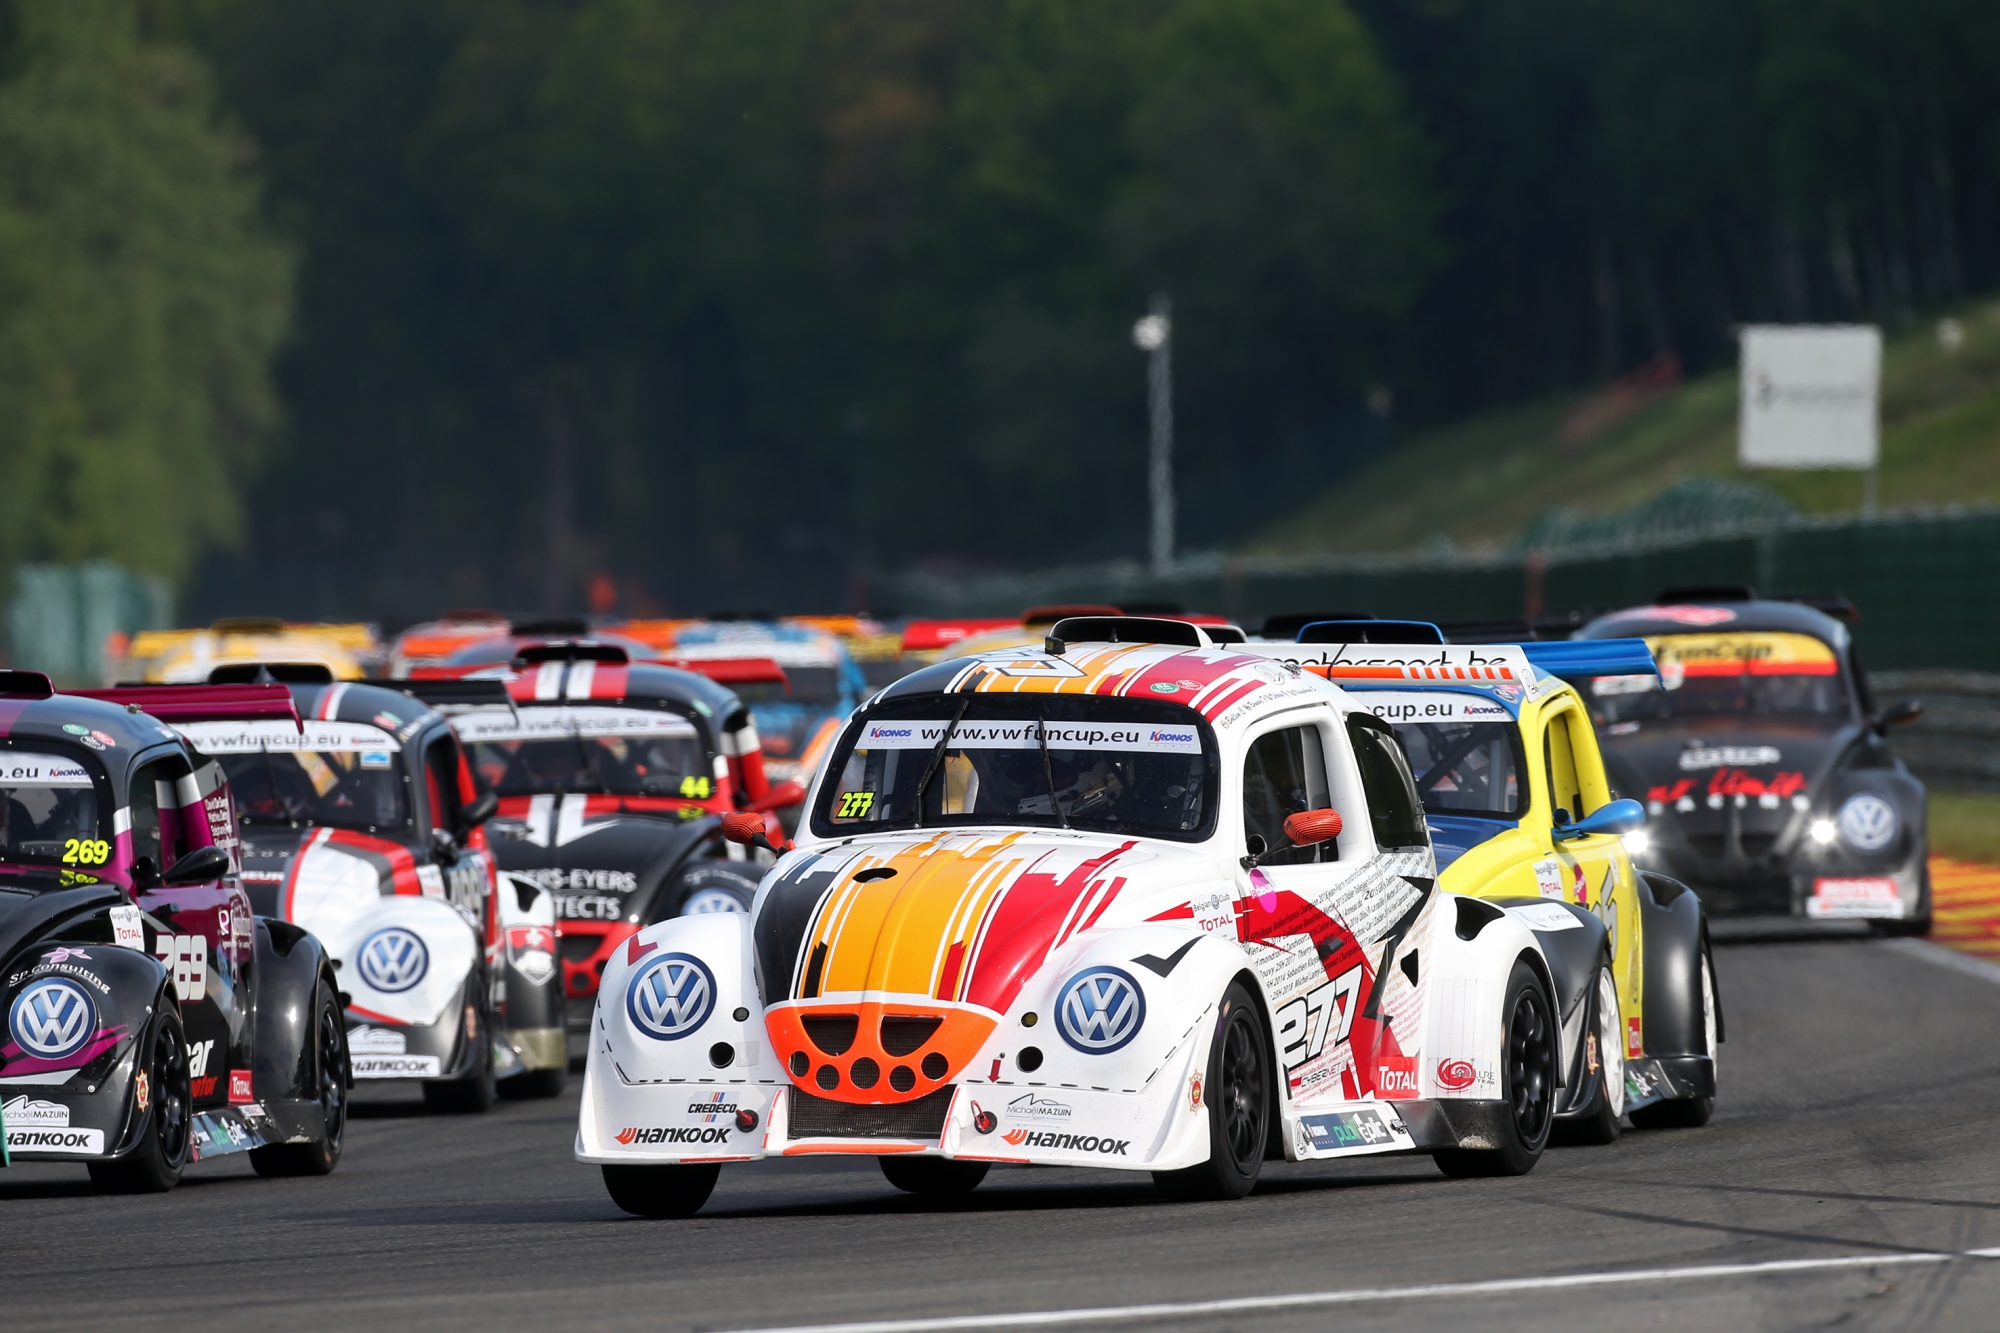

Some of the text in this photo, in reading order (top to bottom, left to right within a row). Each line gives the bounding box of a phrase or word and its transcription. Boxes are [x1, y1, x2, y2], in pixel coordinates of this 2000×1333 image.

[1367, 704, 1452, 721] cup.eu
[1463, 704, 1504, 715] KRONOS
[870, 725, 912, 738] KRONOS
[921, 725, 1139, 745] www.vwfuncup.eu
[1150, 728, 1193, 742] KRONOS
[49, 768, 89, 777] KRONOS
[680, 776, 709, 798] 44
[836, 791, 876, 818] 277
[62, 839, 108, 864] 269
[1540, 880, 1561, 894] TOTAL
[1193, 893, 1230, 912] Belgian Club
[1199, 914, 1233, 931] TOTAL
[116, 928, 142, 940] TOTAL
[9, 963, 111, 995] SP Consulting
[1276, 963, 1363, 1070] 277
[232, 1076, 251, 1095] TOTAL
[1379, 1065, 1417, 1090] TOTAL
[688, 1103, 737, 1114] CREDECO
